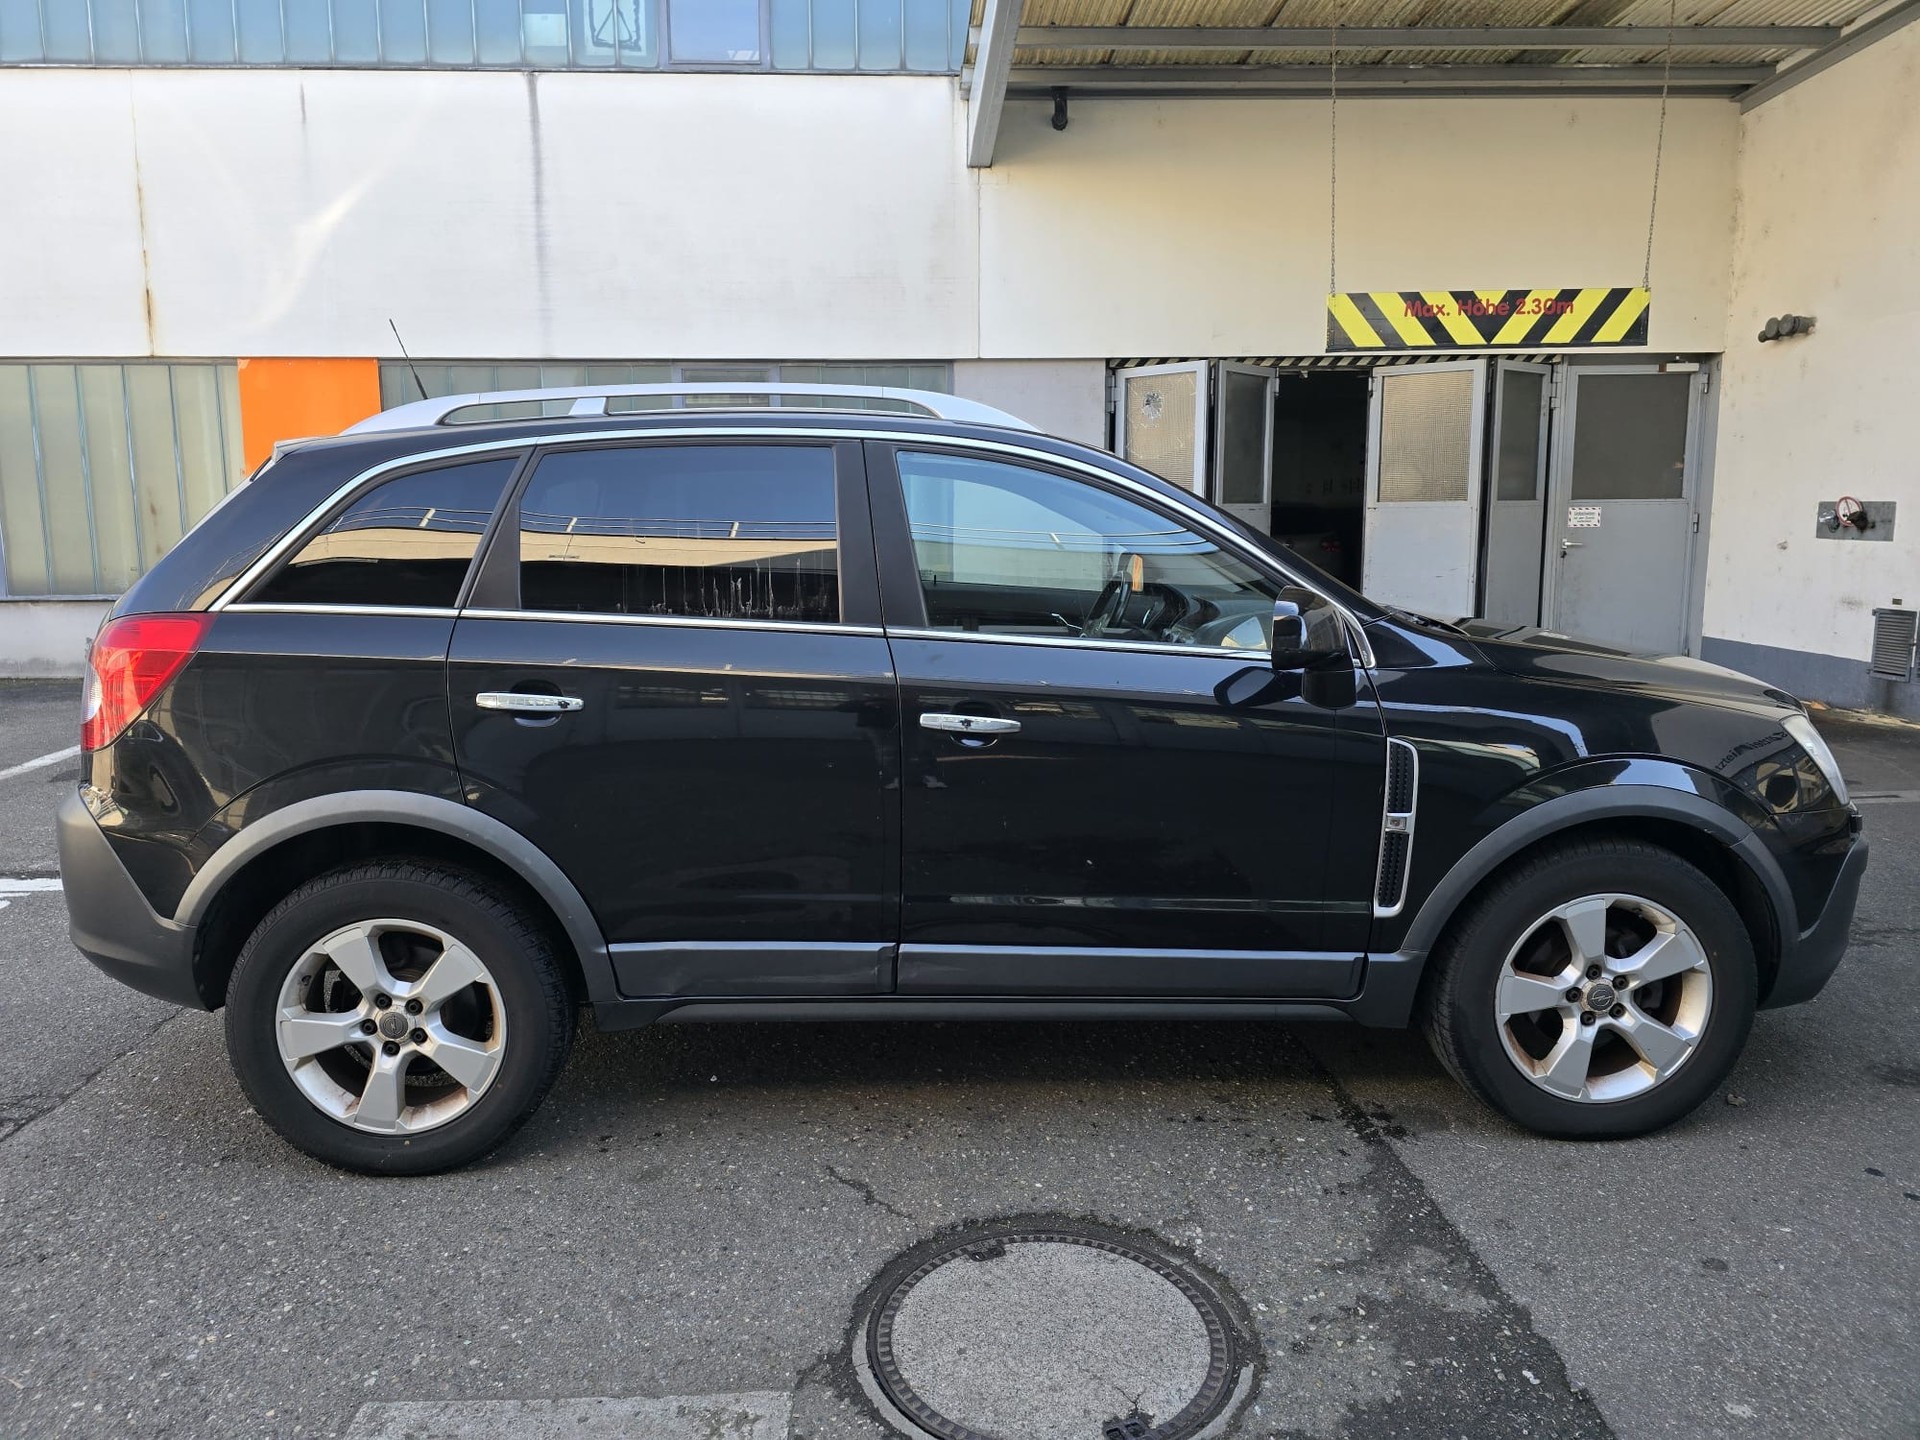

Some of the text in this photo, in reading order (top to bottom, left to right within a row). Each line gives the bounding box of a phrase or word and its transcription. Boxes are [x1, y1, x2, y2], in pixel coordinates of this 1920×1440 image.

[1404, 297, 1574, 317] Max. Höhe 2.30m
